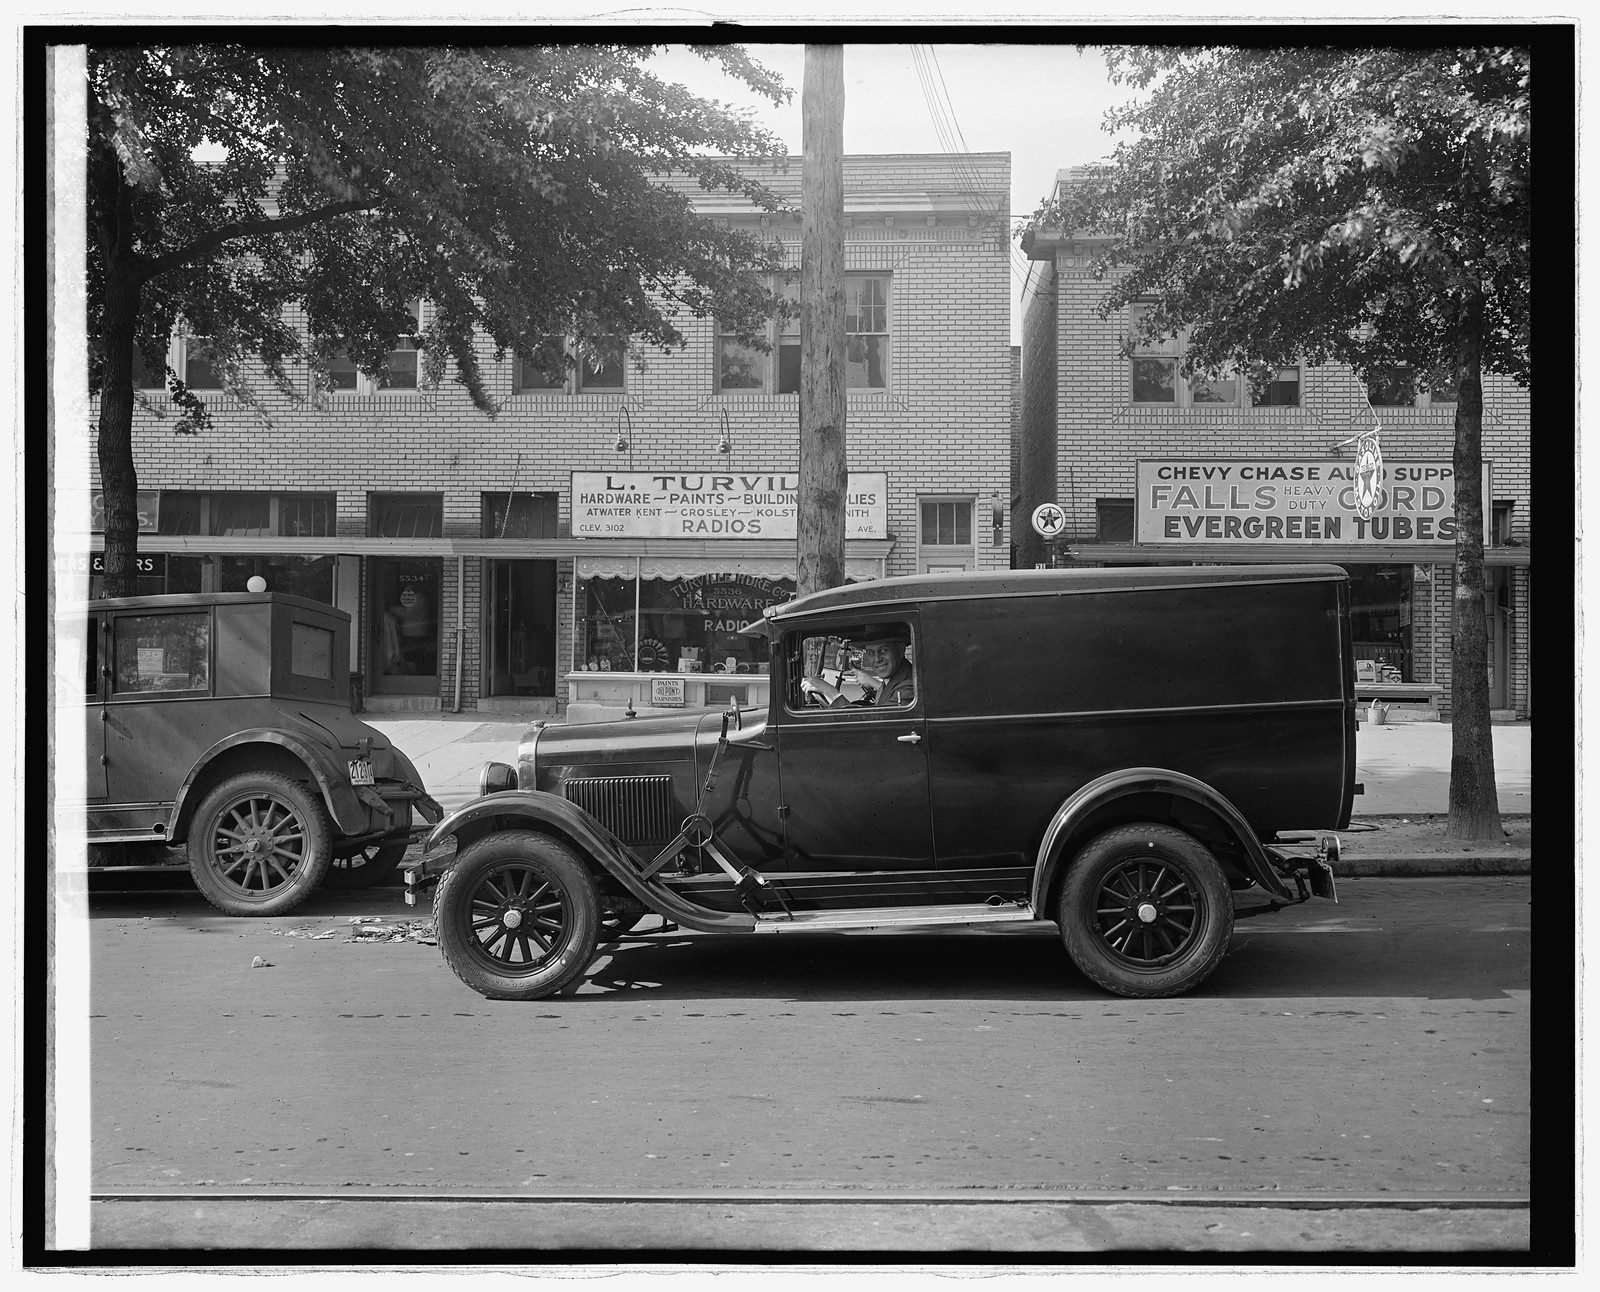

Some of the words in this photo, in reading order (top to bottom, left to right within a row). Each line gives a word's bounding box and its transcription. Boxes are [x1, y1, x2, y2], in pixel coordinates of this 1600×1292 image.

[1157, 466, 1232, 480] CHEVY
[1240, 466, 1320, 481] CHASE
[1328, 467, 1387, 481] AU
[1394, 467, 1455, 481] SUPP
[606, 476, 636, 491] L.
[653, 476, 799, 491] TURVIL
[1284, 486, 1335, 496] HEAVY
[580, 493, 651, 504] HARDWARE
[670, 493, 725, 504] PAINTS
[743, 493, 798, 505] BUILDIN
[1151, 484, 1278, 511] FALLS
[1337, 485, 1456, 512] CRD
[1288, 500, 1327, 510] DUTY
[587, 508, 631, 516] ATWATER
[636, 508, 662, 516] KENT
[680, 508, 737, 517] CROSLEY
[756, 509, 796, 517] KOLST
[846, 509, 870, 517] NITH
[579, 524, 602, 532] CLEV.
[605, 524, 625, 532] 3102
[857, 525, 877, 533] AVE.
[682, 519, 762, 533] RADIOS
[1164, 515, 1341, 539] EVERGREEN
[1352, 516, 1457, 540] TUBES
[670, 573, 732, 597] TURVILLE
[713, 587, 742, 595] 5536
[683, 598, 774, 610] HARDWARE
